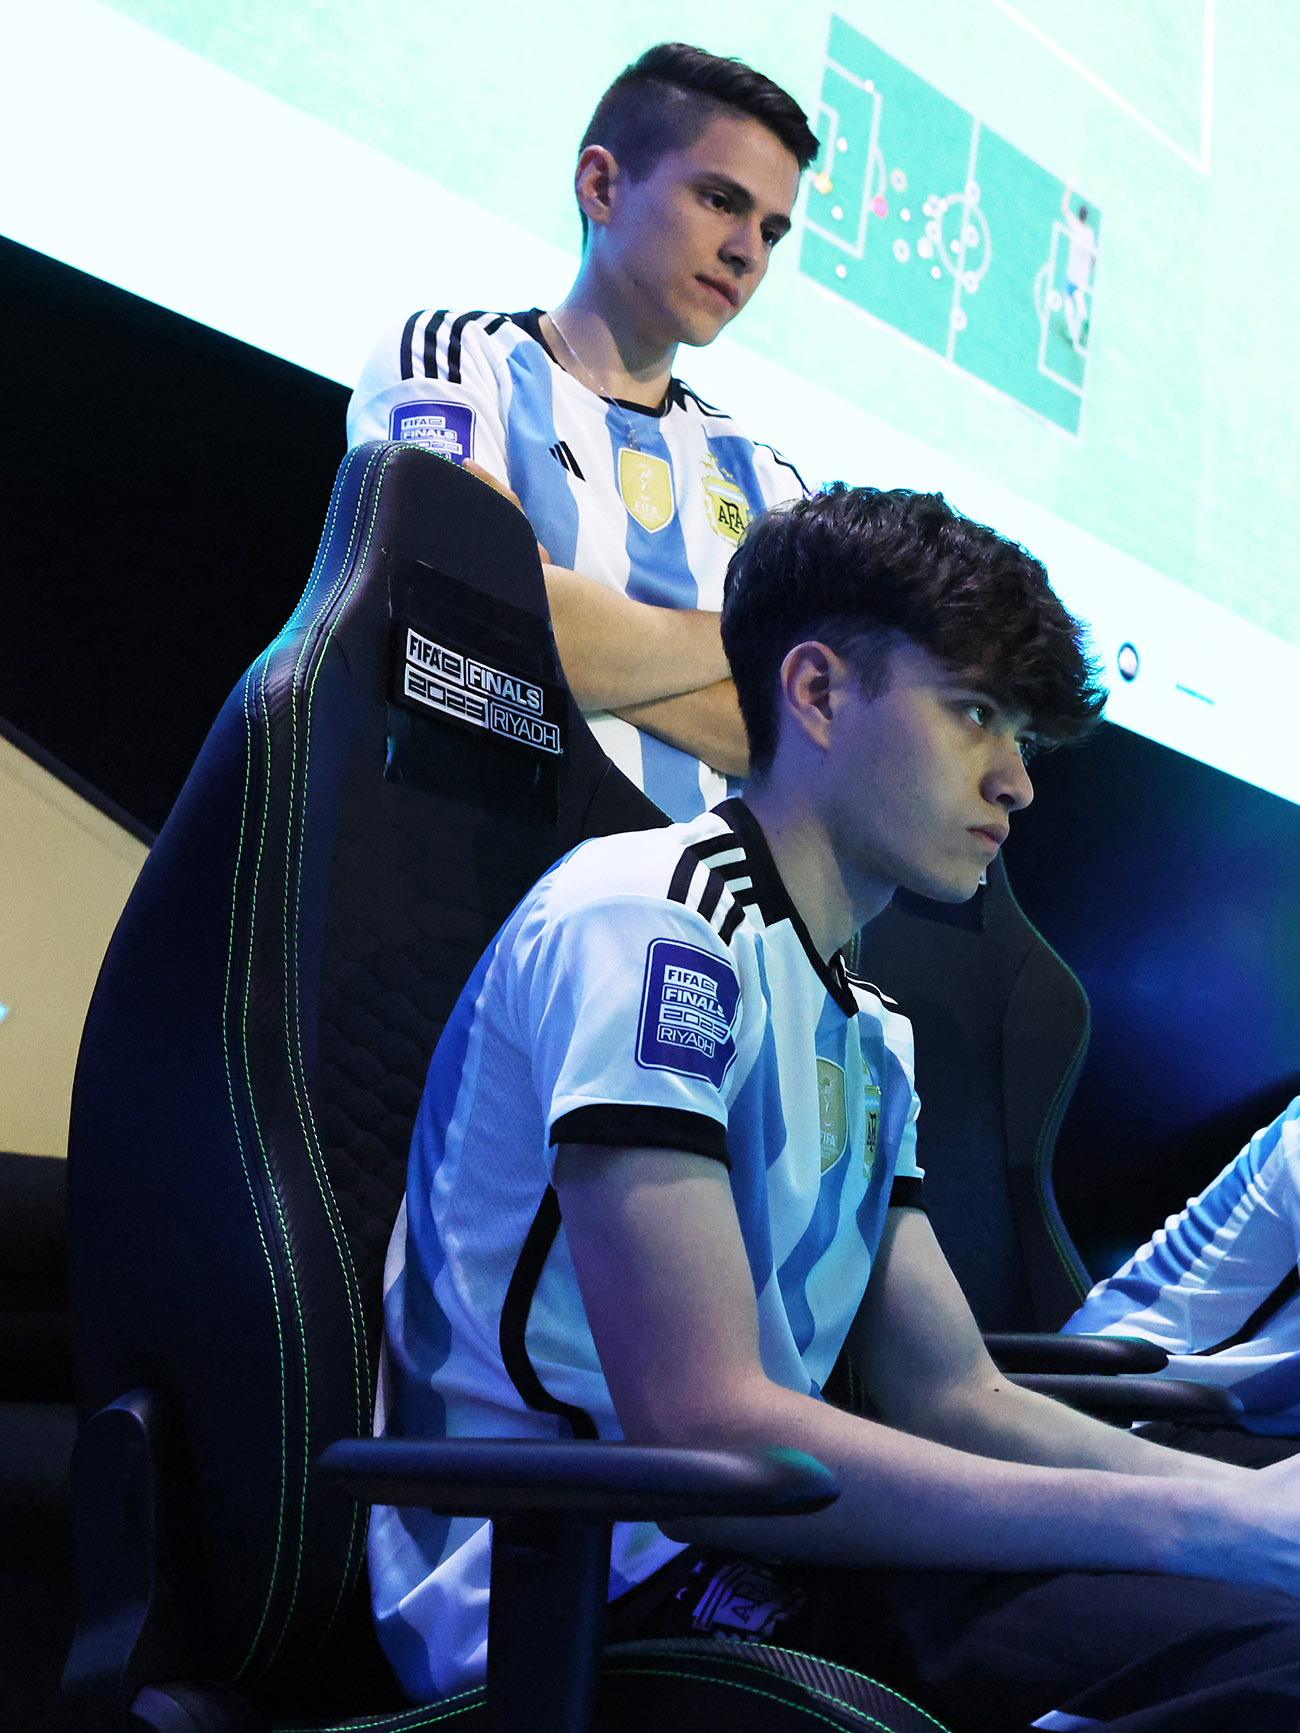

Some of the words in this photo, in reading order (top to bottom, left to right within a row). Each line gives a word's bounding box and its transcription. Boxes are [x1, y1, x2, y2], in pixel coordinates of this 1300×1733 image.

[403, 428, 455, 440] FINALS
[718, 497, 746, 534] AFA
[469, 664, 540, 710] FINALS
[408, 670, 486, 723] 2023
[494, 710, 556, 749] RIYADH
[665, 989, 725, 1018] FINALS
[660, 1027, 714, 1055] RIYADH
[662, 1009, 730, 1041] 2023
